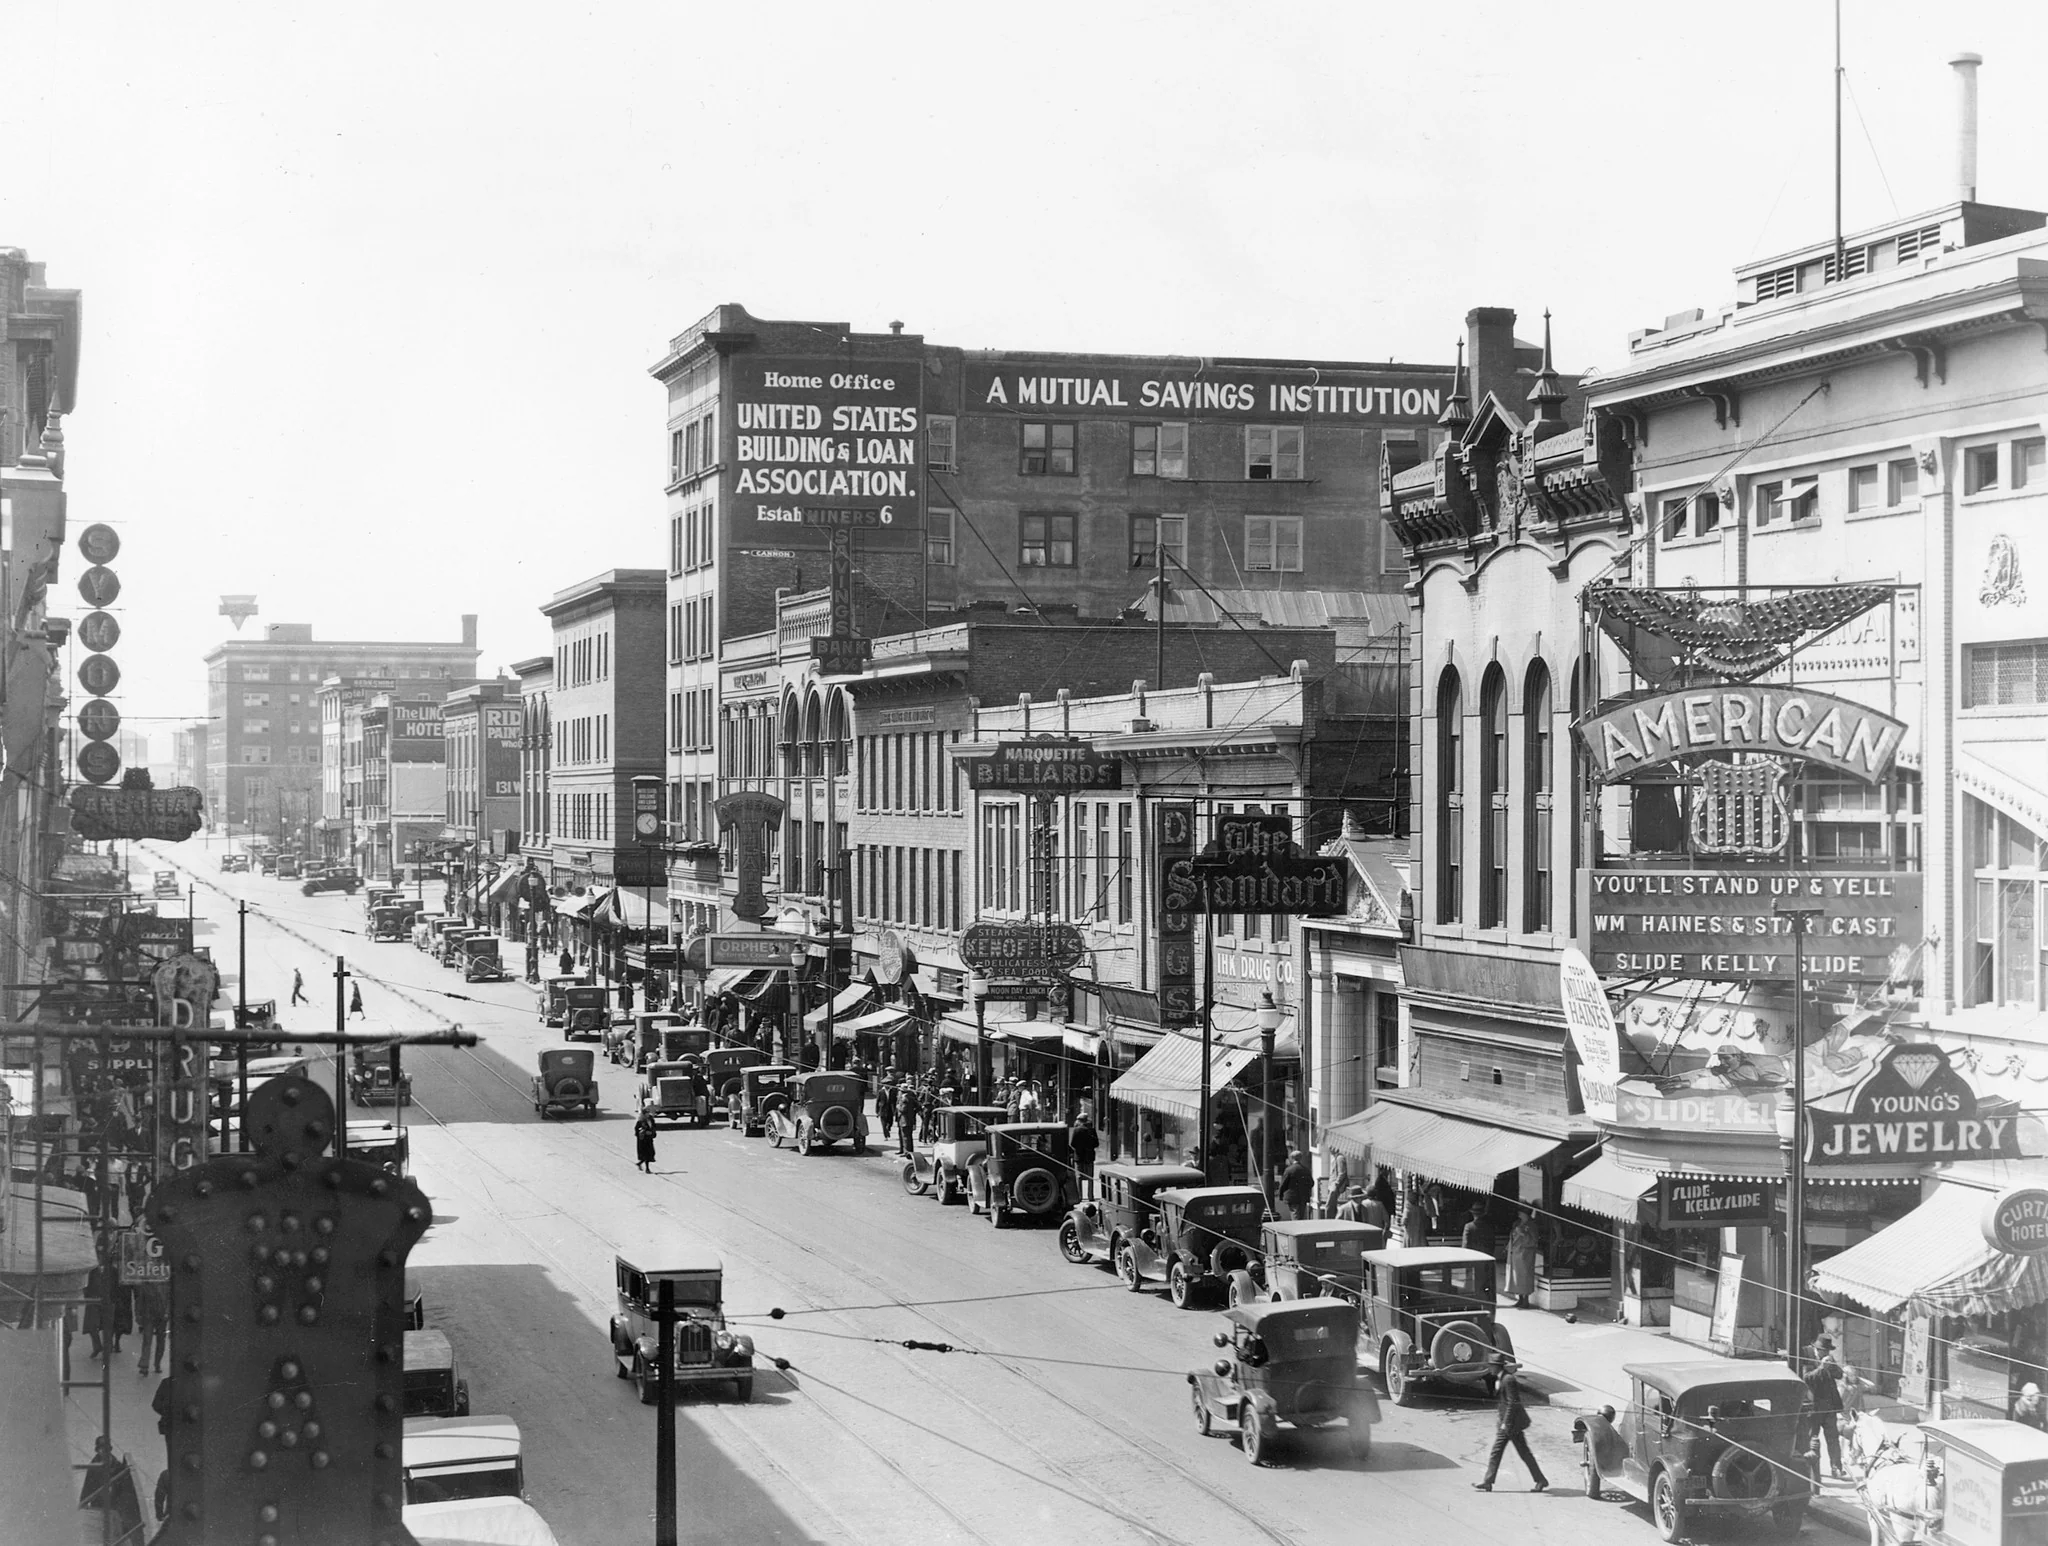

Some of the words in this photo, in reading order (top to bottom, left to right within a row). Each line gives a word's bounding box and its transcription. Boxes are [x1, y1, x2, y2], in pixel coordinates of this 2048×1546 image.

[764, 371, 823, 389] Home
[830, 373, 896, 391] Office
[986, 377, 1008, 404] A
[1018, 377, 1128, 406] MUTUAL
[1139, 381, 1255, 410] SAVINGS
[1270, 384, 1440, 416] INSTITUTION
[736, 403, 822, 430] UNITED
[833, 406, 918, 432] STATES
[736, 436, 834, 463] BUILDING
[856, 438, 915, 466] LOAN
[735, 468, 916, 498] ASSOCIATION.
[757, 505, 802, 522] Estab
[806, 508, 877, 526] MINERS
[834, 529, 850, 635] SAVINGS
[816, 640, 867, 655] BANK
[826, 658, 859, 672] 4%
[395, 706, 418, 720] The
[419, 707, 445, 721] LINC
[486, 709, 522, 725] RID
[406, 722, 445, 737] HOTE
[487, 727, 521, 738] PAIN
[1600, 693, 1893, 774] AMERICAN
[1005, 747, 1085, 763] MARQUETTE
[977, 764, 1112, 784] BILLIARDS
[496, 781, 511, 794] 131
[512, 781, 522, 794] W
[1165, 858, 1346, 911] Sandard
[1594, 876, 1672, 894] YOU'LL
[1682, 877, 1760, 895] STAND
[1771, 878, 1800, 895] UP
[1809, 878, 1822, 895] &
[1832, 878, 1892, 896] YELL
[1164, 810, 1190, 1020] DUGS
[978, 929, 1018, 938] STEAKS
[1594, 916, 1626, 934] WM
[1642, 916, 1721, 935] HAINES
[1732, 916, 1746, 935] &
[1833, 918, 1893, 936] CAST
[998, 968, 1017, 977] SEA
[1021, 968, 1048, 977] FOOD
[1241, 956, 1271, 981] DRUG
[1276, 961, 1295, 984] CO.
[1616, 953, 1683, 972] SLIDE
[1701, 954, 1778, 973] KELLY
[1011, 986, 1024, 995] DAY
[1026, 986, 1046, 995] LUNCH
[1563, 977, 1602, 1005] WILLIAM
[1568, 1001, 1611, 1031] HAINES
[172, 998, 195, 1170] DRUG
[1724, 1099, 1776, 1127] KEL
[1870, 1093, 1961, 1113] YOUNG'S
[1822, 1119, 2009, 1156] JEWELRY
[2001, 1200, 2048, 1227] CURTI
[2011, 1223, 2048, 1242] HOTE
[2012, 1495, 2048, 1506] SUP
